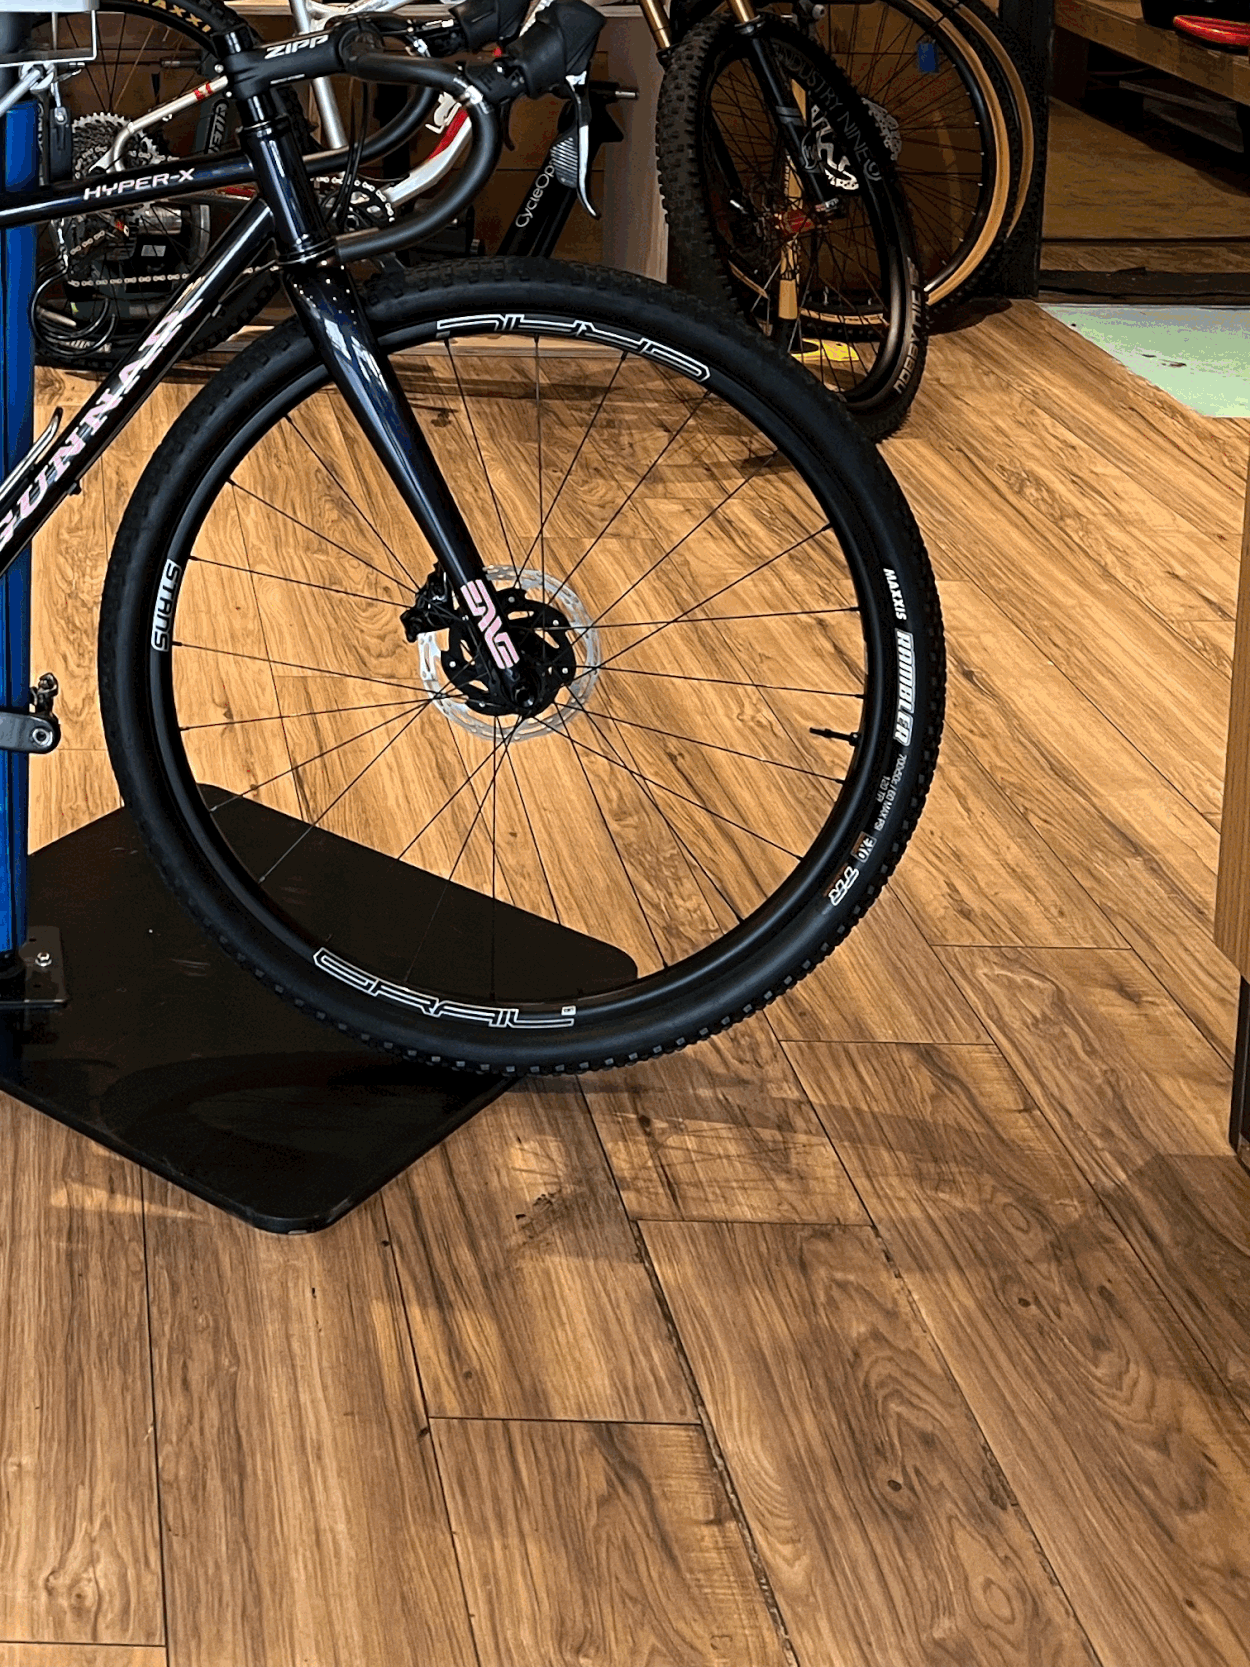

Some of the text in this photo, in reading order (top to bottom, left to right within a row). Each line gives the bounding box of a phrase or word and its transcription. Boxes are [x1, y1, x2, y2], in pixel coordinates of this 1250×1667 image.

[264, 34, 329, 60] ZIPP
[837, 110, 871, 162] NINE
[83, 167, 196, 201] HYPER-X
[514, 159, 556, 229] CycleOp
[882, 567, 907, 621] MAXXIS
[894, 628, 916, 746] RAMBLER
